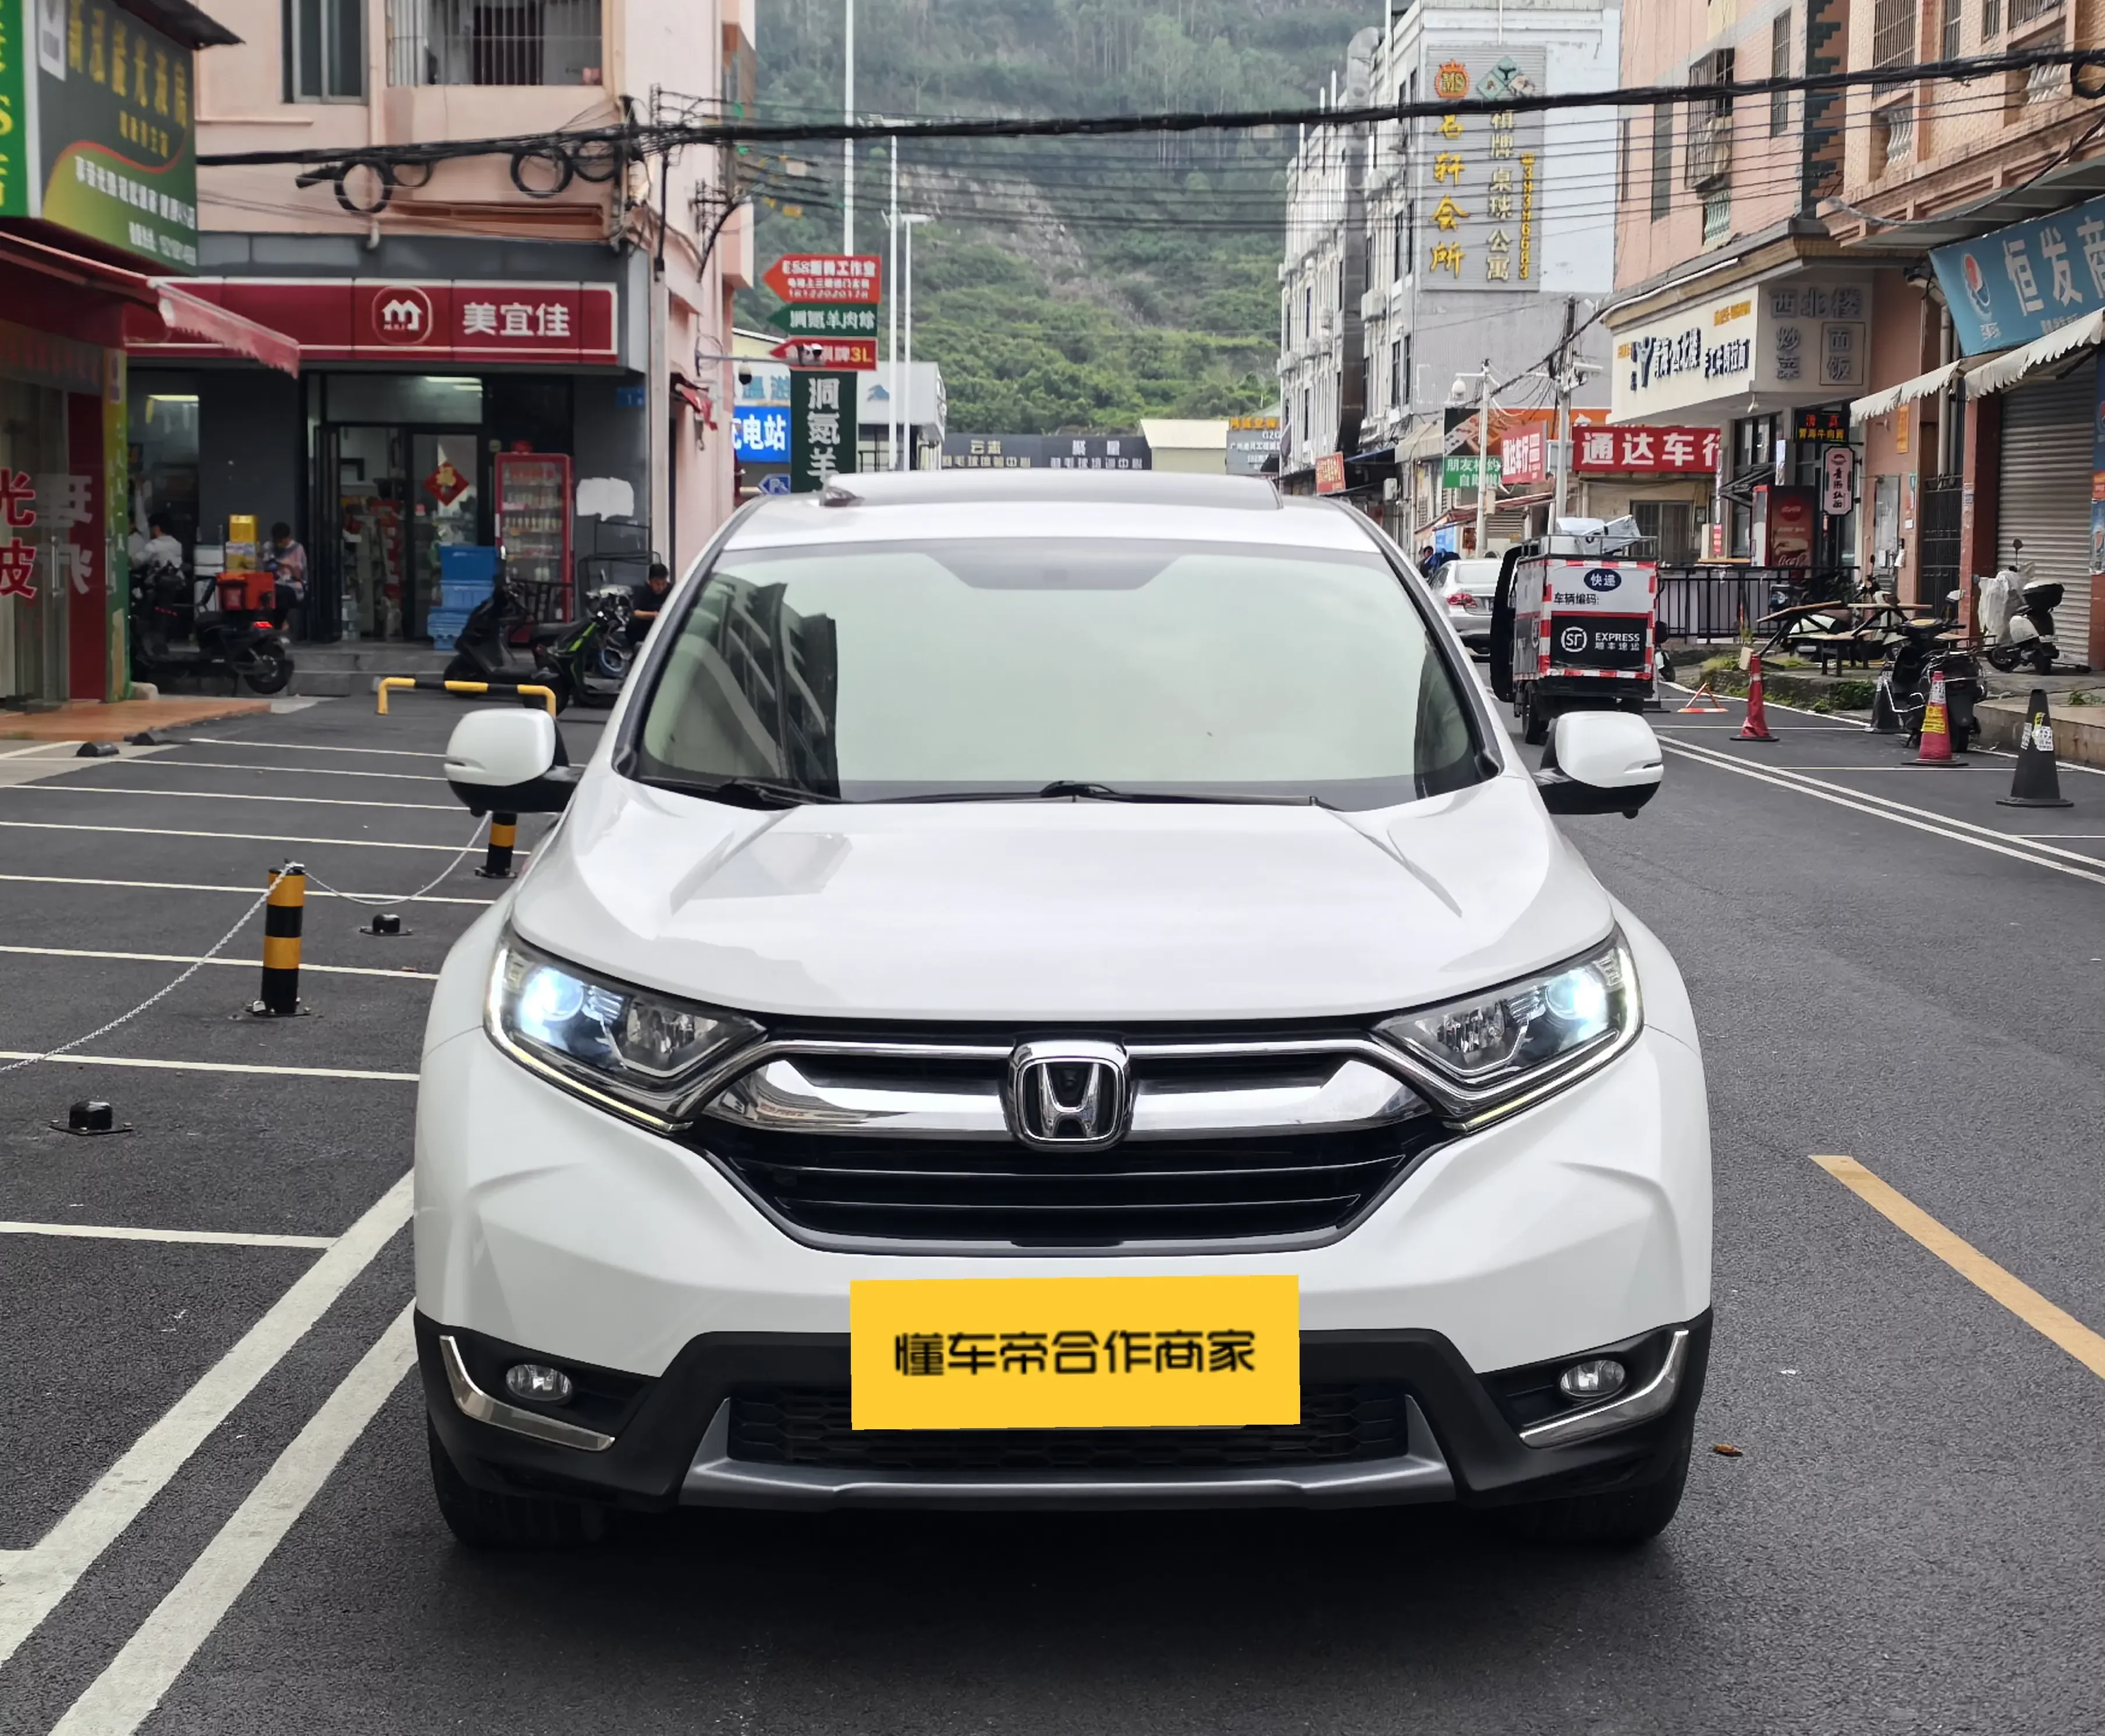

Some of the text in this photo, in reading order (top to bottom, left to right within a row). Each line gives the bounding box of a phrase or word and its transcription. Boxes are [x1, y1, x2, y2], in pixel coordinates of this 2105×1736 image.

[1769, 287, 1861, 318] 西北楼
[462, 302, 571, 337] 美宜佳
[1582, 432, 1721, 466] 通达车行
[1590, 574, 1616, 587] 快递
[1595, 632, 1640, 642] EXPRESS
